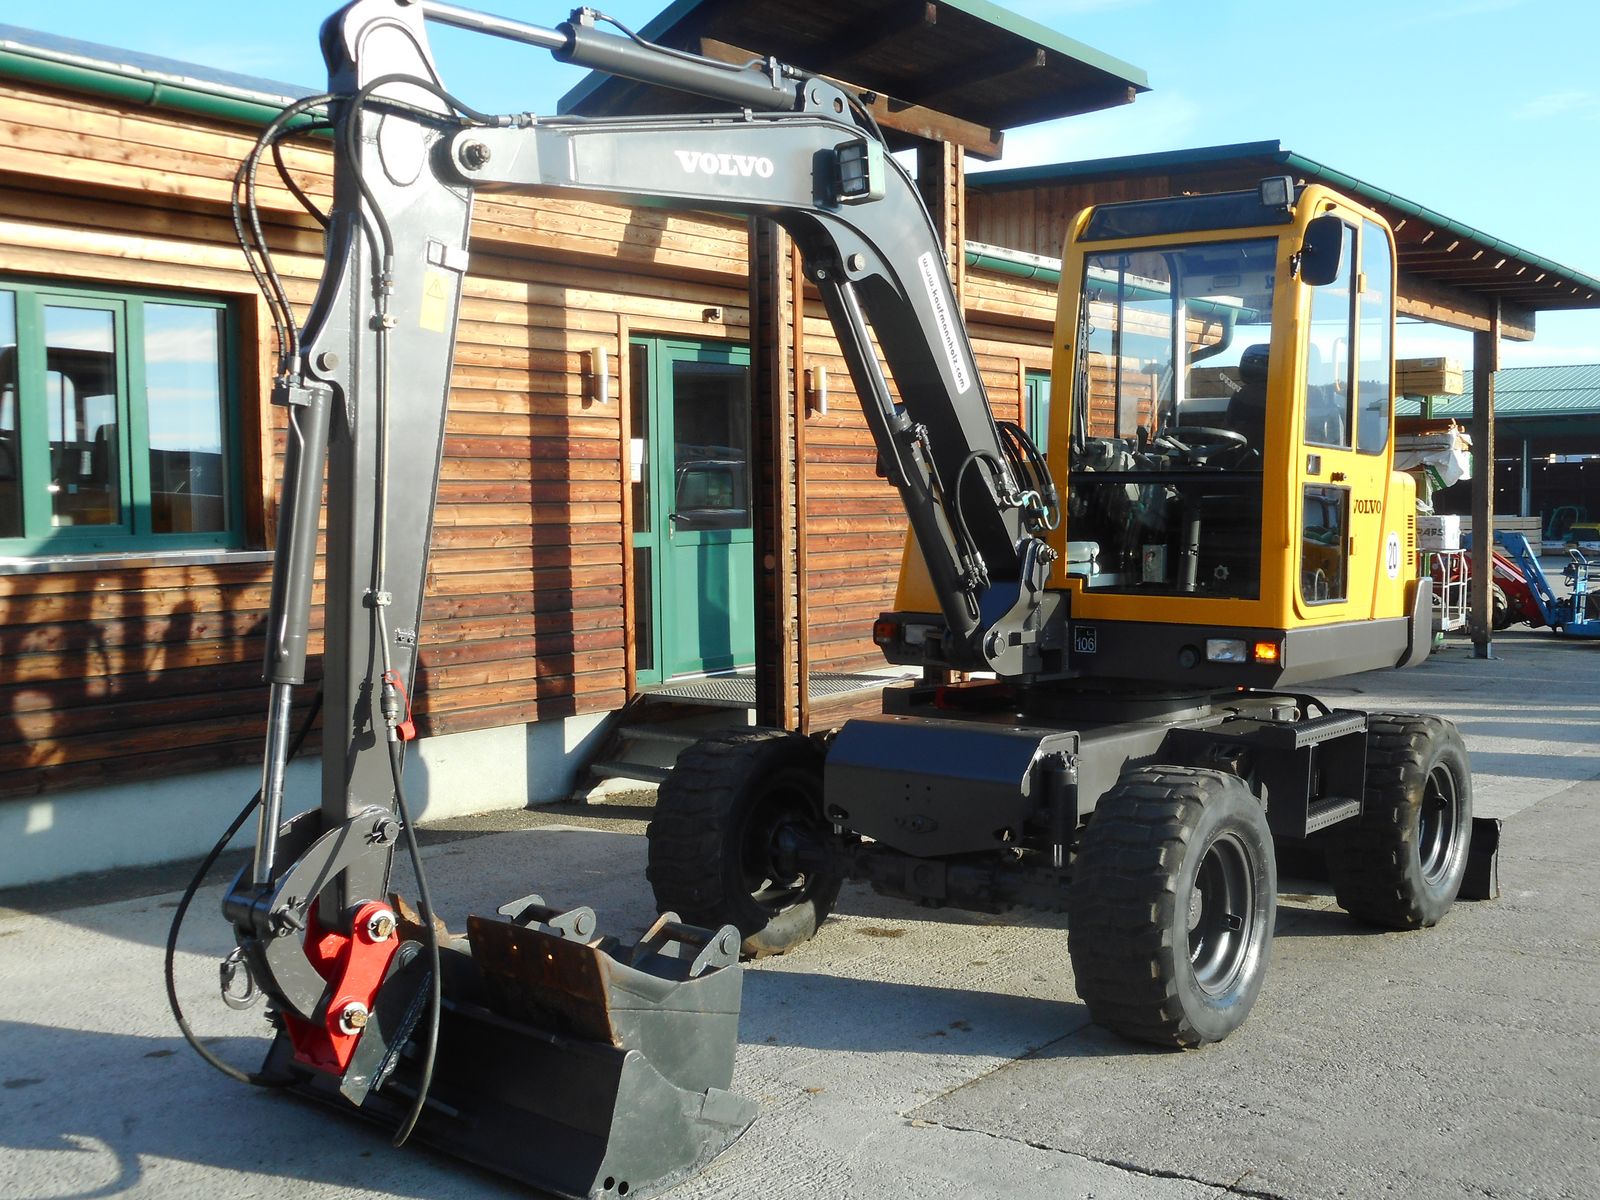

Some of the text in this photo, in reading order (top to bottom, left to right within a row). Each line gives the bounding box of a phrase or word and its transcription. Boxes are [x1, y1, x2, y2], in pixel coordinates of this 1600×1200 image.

[674, 150, 774, 178] VOLVO
[921, 256, 966, 389] www.kaufmannholz.com
[1353, 499, 1382, 514] VOLVO
[1388, 541, 1398, 571] 20
[1076, 636, 1096, 651] 106
